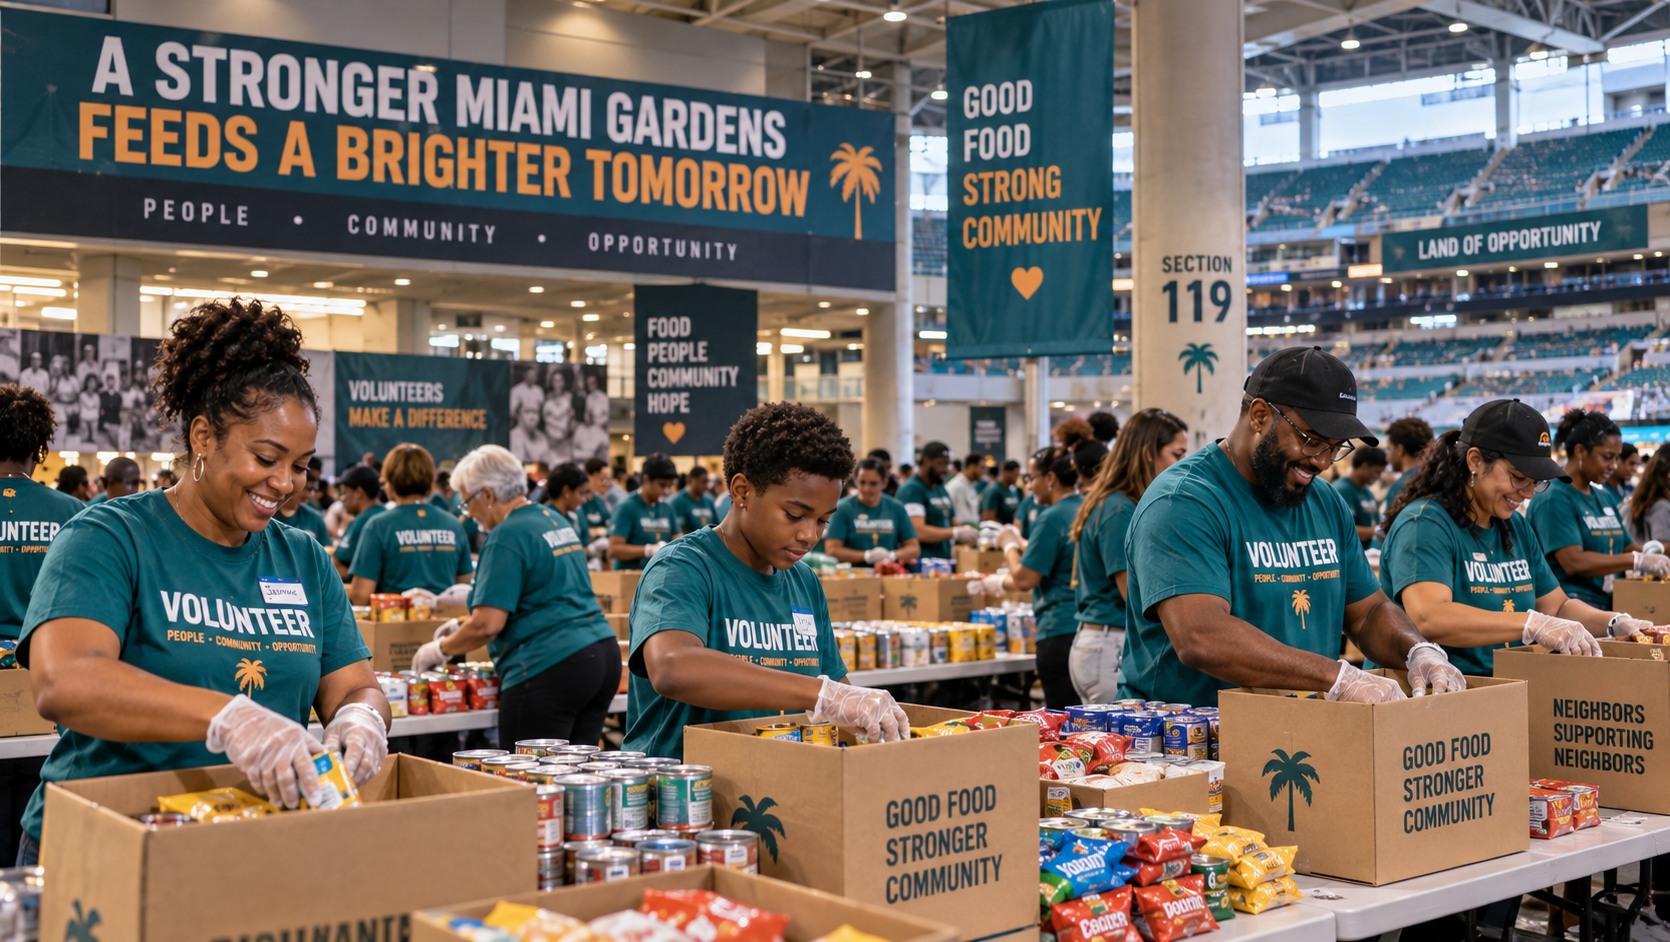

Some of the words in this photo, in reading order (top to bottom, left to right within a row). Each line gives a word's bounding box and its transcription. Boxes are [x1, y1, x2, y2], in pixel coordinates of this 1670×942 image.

[91, 35, 134, 96] A
[155, 41, 439, 125] STRONGER
[455, 73, 592, 140] MIAMI
[606, 91, 787, 160] GARDENS
[963, 79, 1033, 119] GOOD
[79, 101, 259, 173] FEEDS
[278, 120, 316, 178] A
[336, 124, 572, 199] BRIGHTER
[586, 148, 811, 218] TOMORROW
[964, 123, 1031, 162] FOOD
[963, 165, 1062, 206] STRONG
[144, 198, 249, 227] PEOPLE
[347, 213, 497, 245] COMMUNITY
[588, 232, 738, 262] OPPORTUNITY
[963, 206, 1103, 250] COMMUNITY
[1418, 236, 1459, 260] LAND
[1463, 233, 1484, 256] OF
[1487, 220, 1602, 253] OPPORTUNITY
[1162, 255, 1232, 273] SECTION
[1162, 280, 1232, 323] 119
[647, 316, 691, 339] FOOD
[647, 341, 709, 363] PEOPLE
[348, 379, 444, 404] VOLUNTEERS
[647, 365, 740, 389] COMMUNITY
[348, 406, 391, 428] MAKE
[393, 407, 405, 428] A
[407, 407, 488, 430] DIFFERENCE
[647, 392, 691, 414] HOPE
[394, 529, 457, 546] VOLUNTEER
[1245, 538, 1339, 569] VOLUNTEER
[1463, 559, 1532, 583] VOLUNTEER
[160, 590, 315, 639] VOLUNTEER
[167, 629, 205, 643] PEOPLE
[216, 635, 262, 652] COMMUNITY
[725, 618, 819, 652] VOLUNTEER
[1553, 698, 1645, 724] NEIGHBORS
[1403, 740, 1446, 771] GOOD
[1451, 732, 1491, 762] FOOD
[1554, 723, 1654, 750] SUPPORTING
[1554, 747, 1645, 775] NEIGHBORS
[1403, 764, 1484, 802] STRONGER
[886, 794, 941, 829] GOOD
[948, 784, 997, 819] FOOD
[1404, 792, 1495, 834] COMMUNITY
[886, 822, 988, 867] STRONGER
[886, 853, 1003, 905] COMMUNITY
